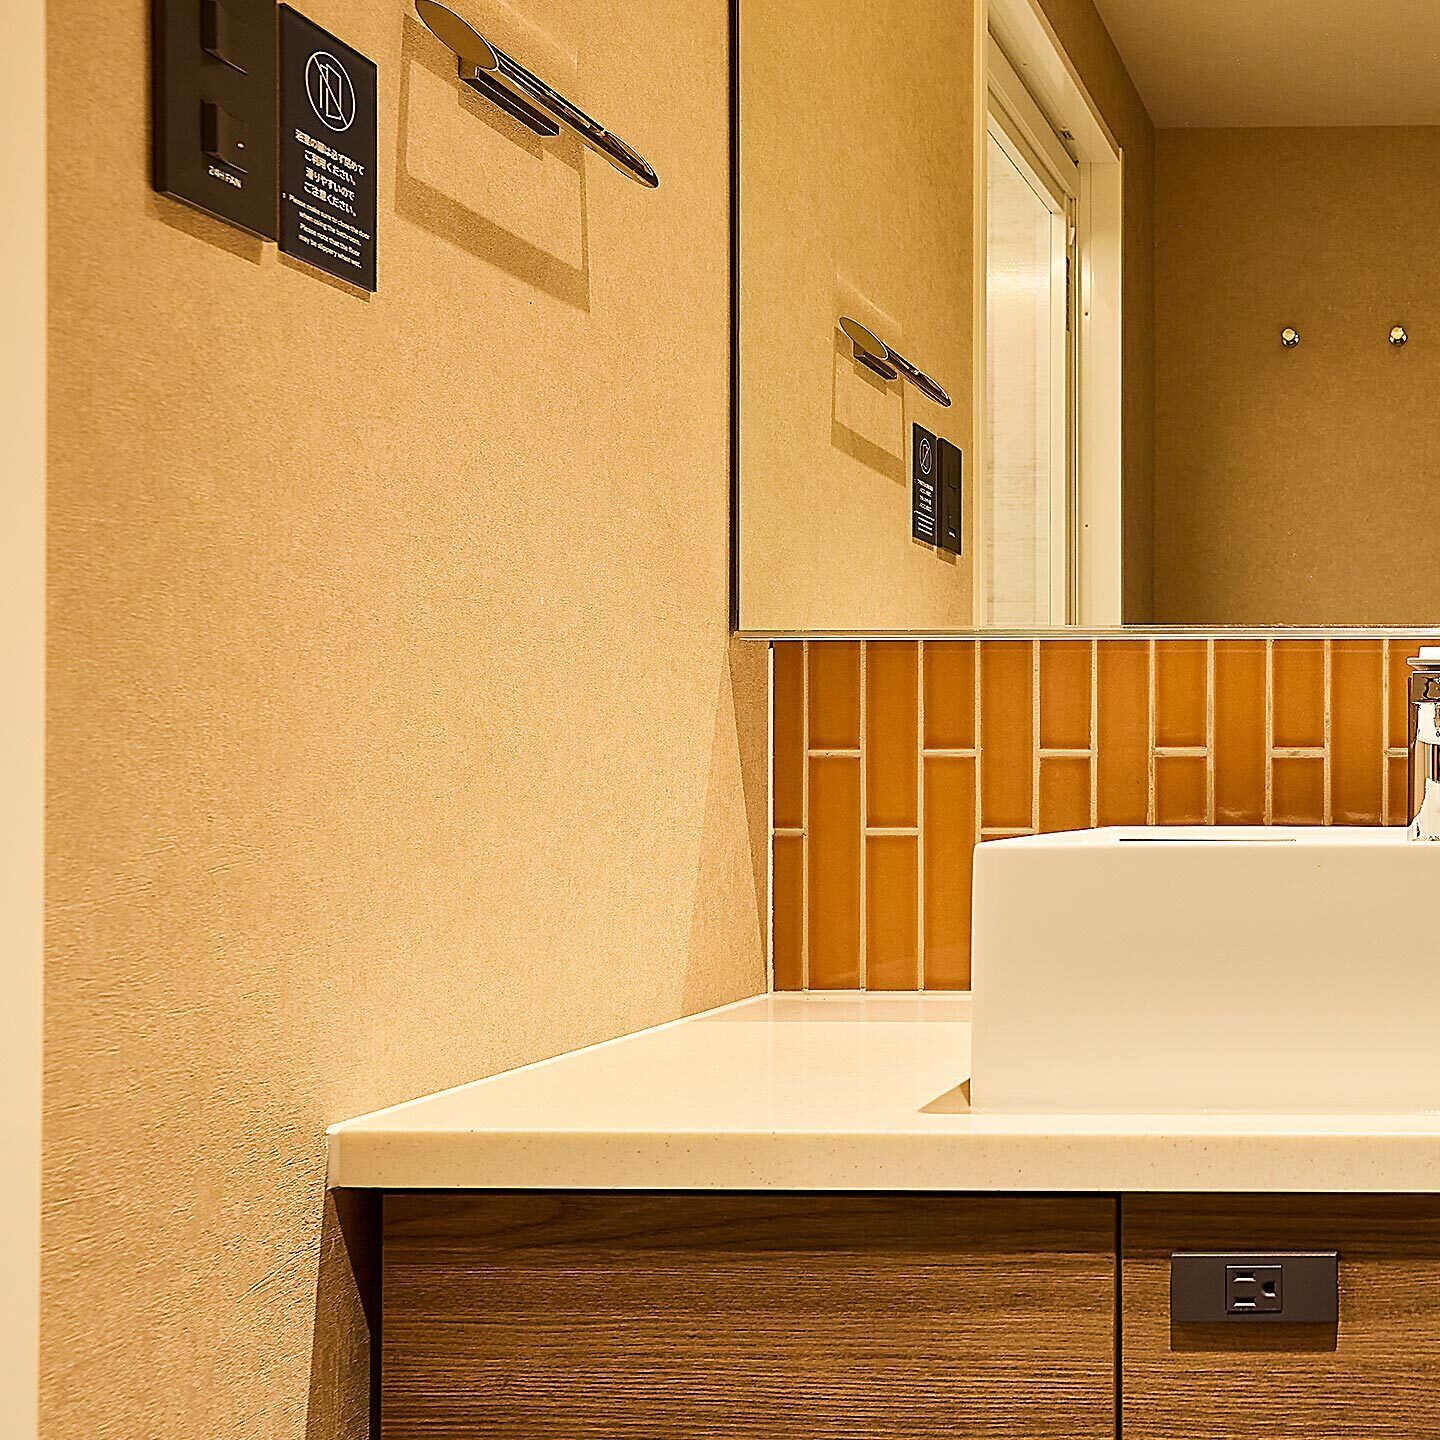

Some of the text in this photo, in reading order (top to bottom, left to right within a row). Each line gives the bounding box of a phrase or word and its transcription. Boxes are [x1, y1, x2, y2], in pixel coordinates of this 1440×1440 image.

[304, 150, 356, 186] ご利用ください。
[306, 166, 356, 201] 滑りやすいので
[304, 181, 356, 216] ご注意ください。
[289, 194, 306, 208] Please
[359, 231, 370, 240] door
[300, 222, 316, 236] Please
[298, 234, 309, 244] may
[318, 243, 337, 257] slippery
